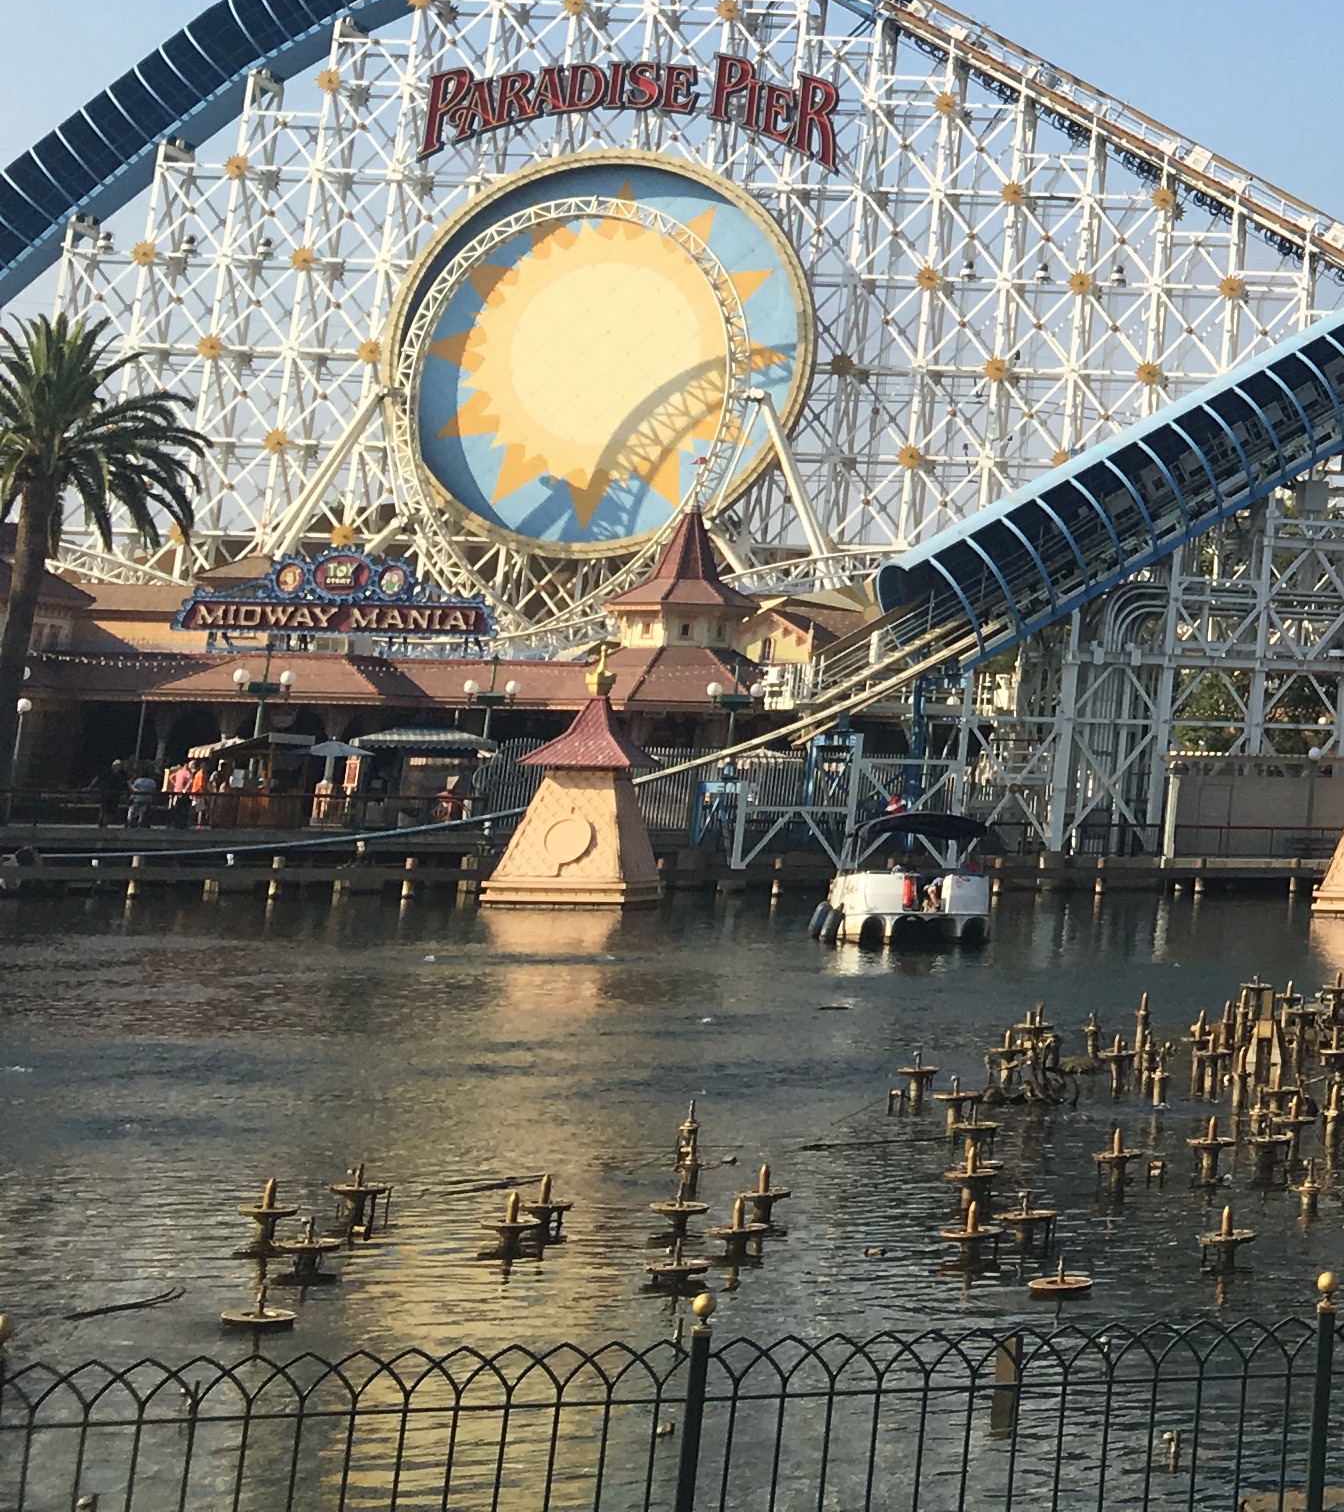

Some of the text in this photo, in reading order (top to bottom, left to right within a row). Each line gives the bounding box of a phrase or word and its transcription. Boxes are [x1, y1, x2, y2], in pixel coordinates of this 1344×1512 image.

[416, 51, 840, 175] PARADISE PIER
[326, 562, 359, 577] TOY
[326, 577, 352, 585] STORY
[194, 604, 476, 631] MIDWAY MANIA!
